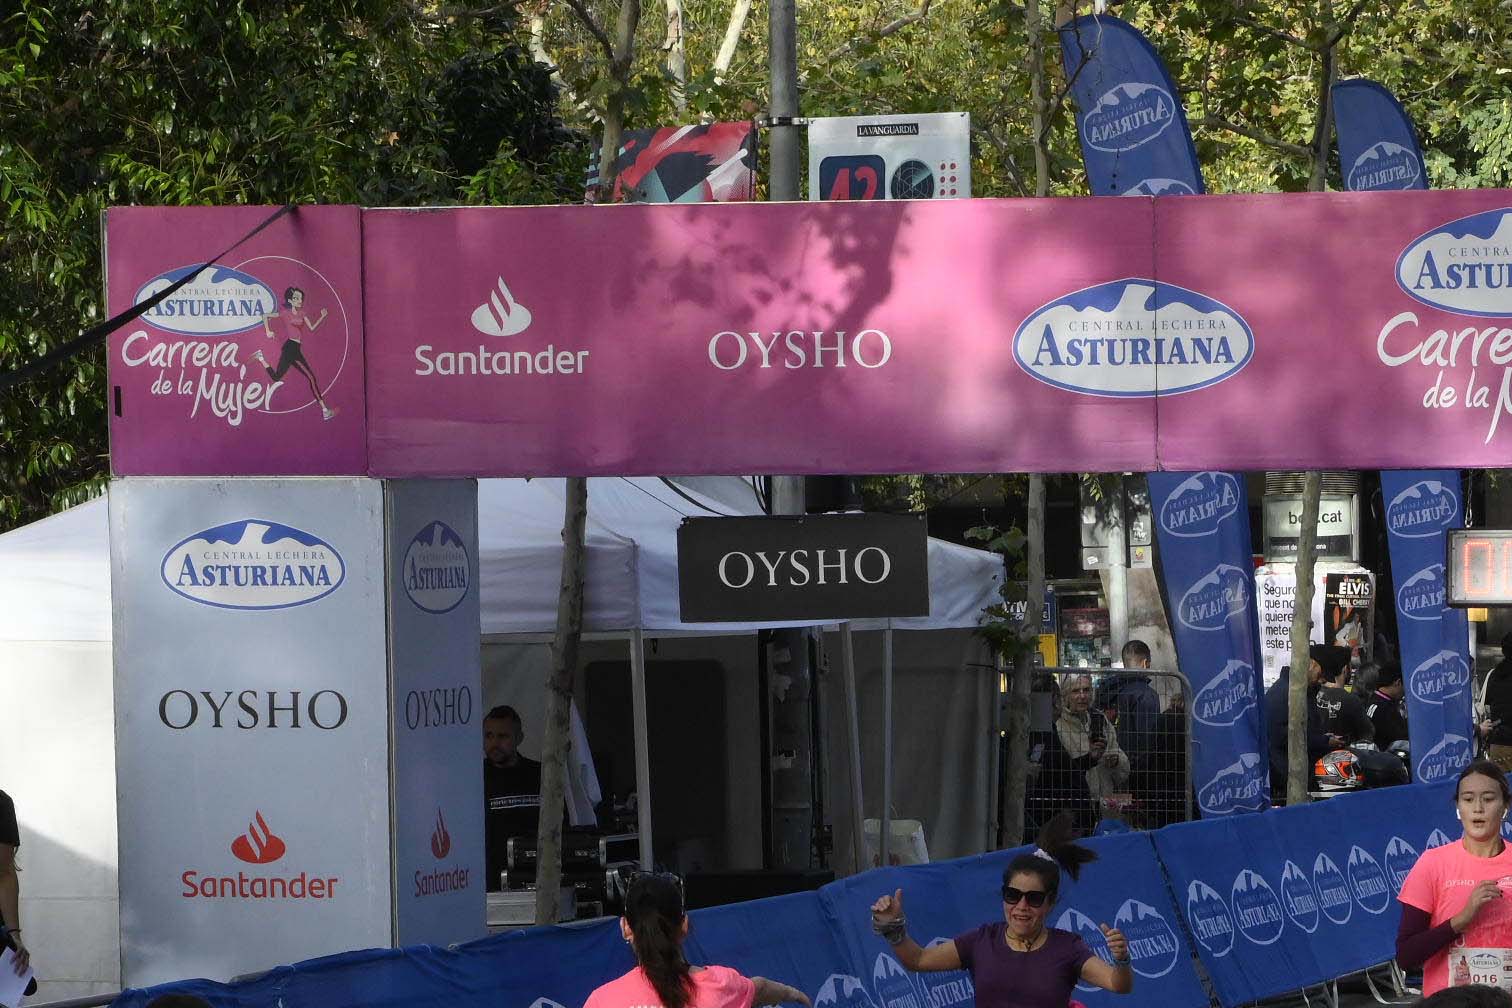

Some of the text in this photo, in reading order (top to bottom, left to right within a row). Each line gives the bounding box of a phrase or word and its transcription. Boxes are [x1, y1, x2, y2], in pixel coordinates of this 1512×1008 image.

[859, 124, 918, 136] LA VANGUARDIA
[1069, 319, 1227, 332] CENTRAL LECHERA
[121, 331, 239, 367] Carrera
[415, 344, 589, 376] Santander
[707, 329, 892, 370] OYSHO
[1032, 324, 1235, 368] ASTURIANA
[151, 364, 283, 426] de la Mujer
[1422, 371, 1457, 410] de
[1466, 371, 1490, 409] la
[176, 553, 332, 587] ASTURIANA
[204, 551, 325, 561] CENTRAL LECHERA
[718, 547, 891, 588] OYSHO
[408, 557, 466, 592] ASTURIANA
[1339, 582, 1369, 595] ELVIS
[1265, 600, 1281, 613] que
[1265, 611, 1293, 625] quiere
[1266, 638, 1285, 648] este
[158, 689, 348, 730] OYSHO
[405, 685, 472, 730] OYSHO
[182, 871, 338, 899] Santander
[414, 865, 469, 898] Santander
[1473, 973, 1497, 984] 016
